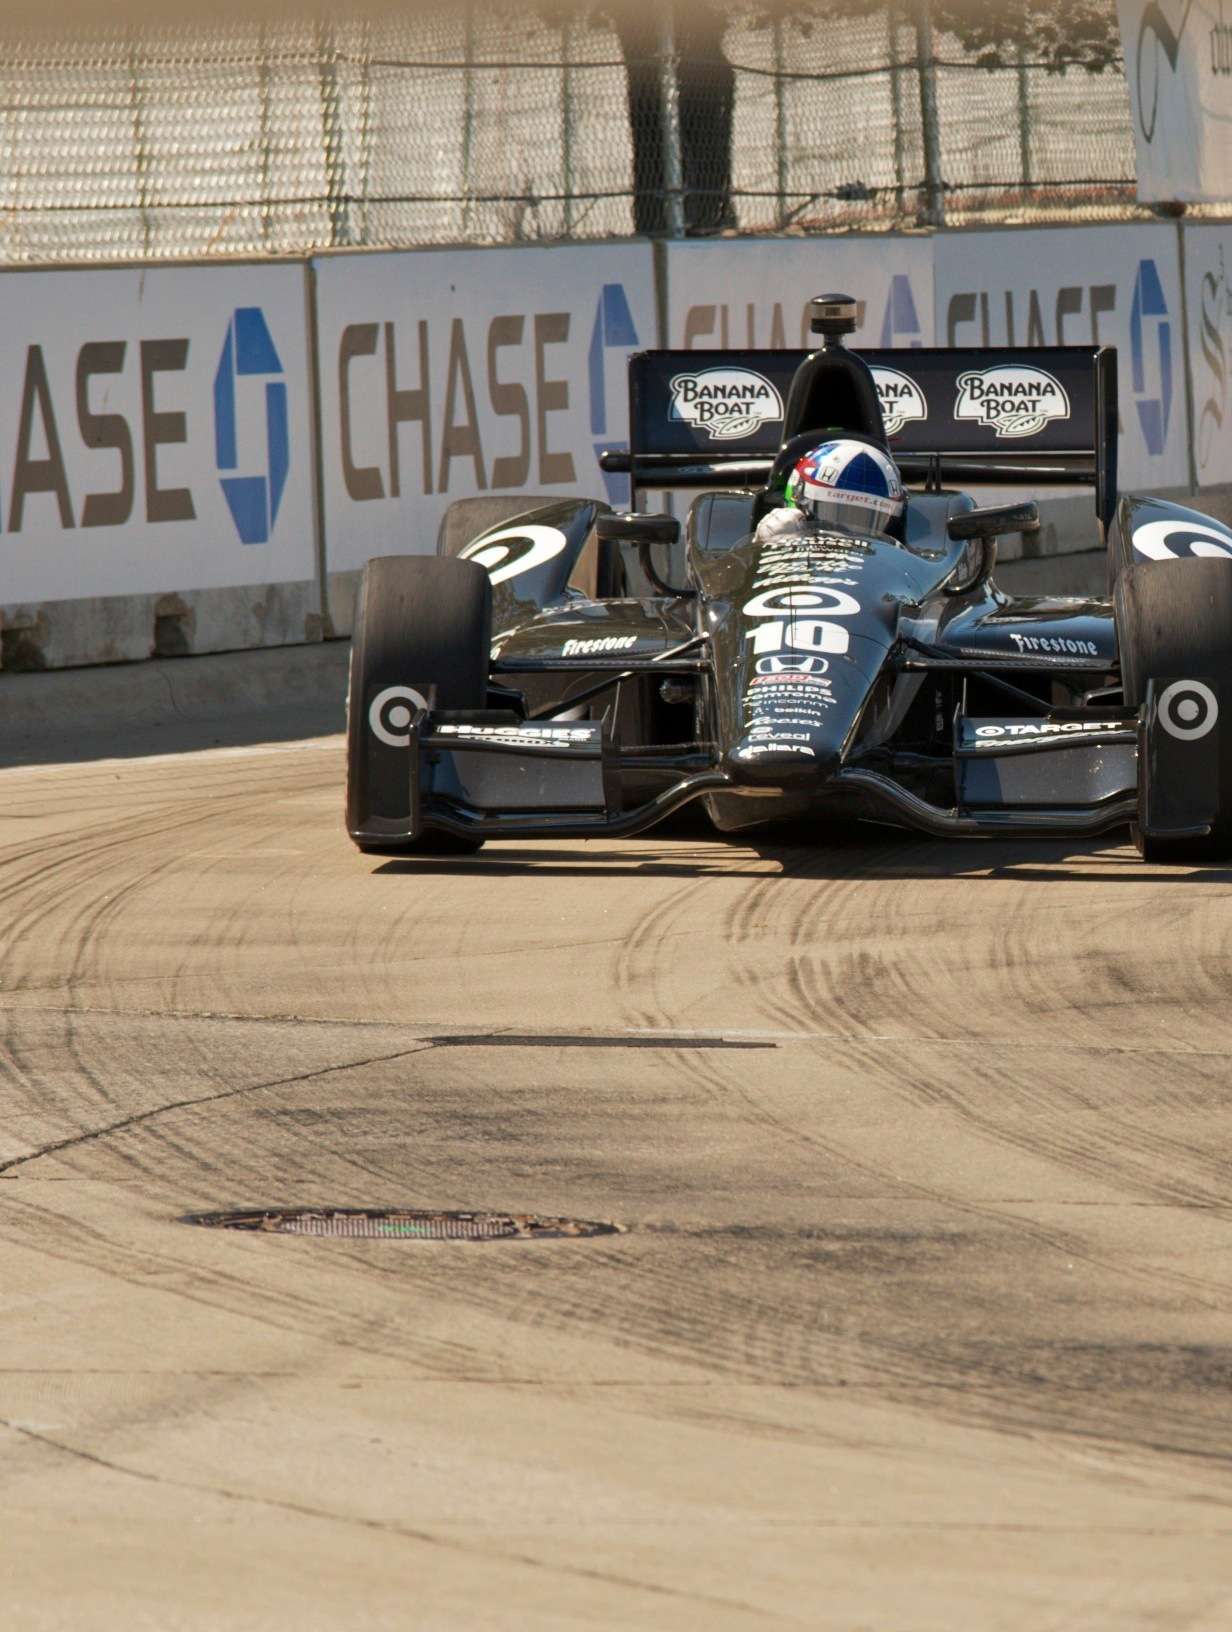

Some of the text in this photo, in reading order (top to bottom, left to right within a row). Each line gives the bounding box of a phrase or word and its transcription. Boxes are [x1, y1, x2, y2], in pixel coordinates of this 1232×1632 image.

[677, 379, 770, 402] BANANA
[964, 376, 1056, 400] BANANA
[338, 312, 577, 501] CHASE
[694, 401, 755, 422] BOAT
[980, 398, 1040, 420] BOAT
[3, 338, 196, 533] ASE
[561, 635, 638, 657] Firestone
[745, 620, 849, 654] 10
[1010, 633, 1098, 655] Firestone
[747, 685, 833, 696] PHILIPS
[774, 707, 822, 716] belkin
[748, 732, 811, 742] reveal
[1004, 722, 1122, 735] TARGET
[738, 743, 815, 758] dallara
